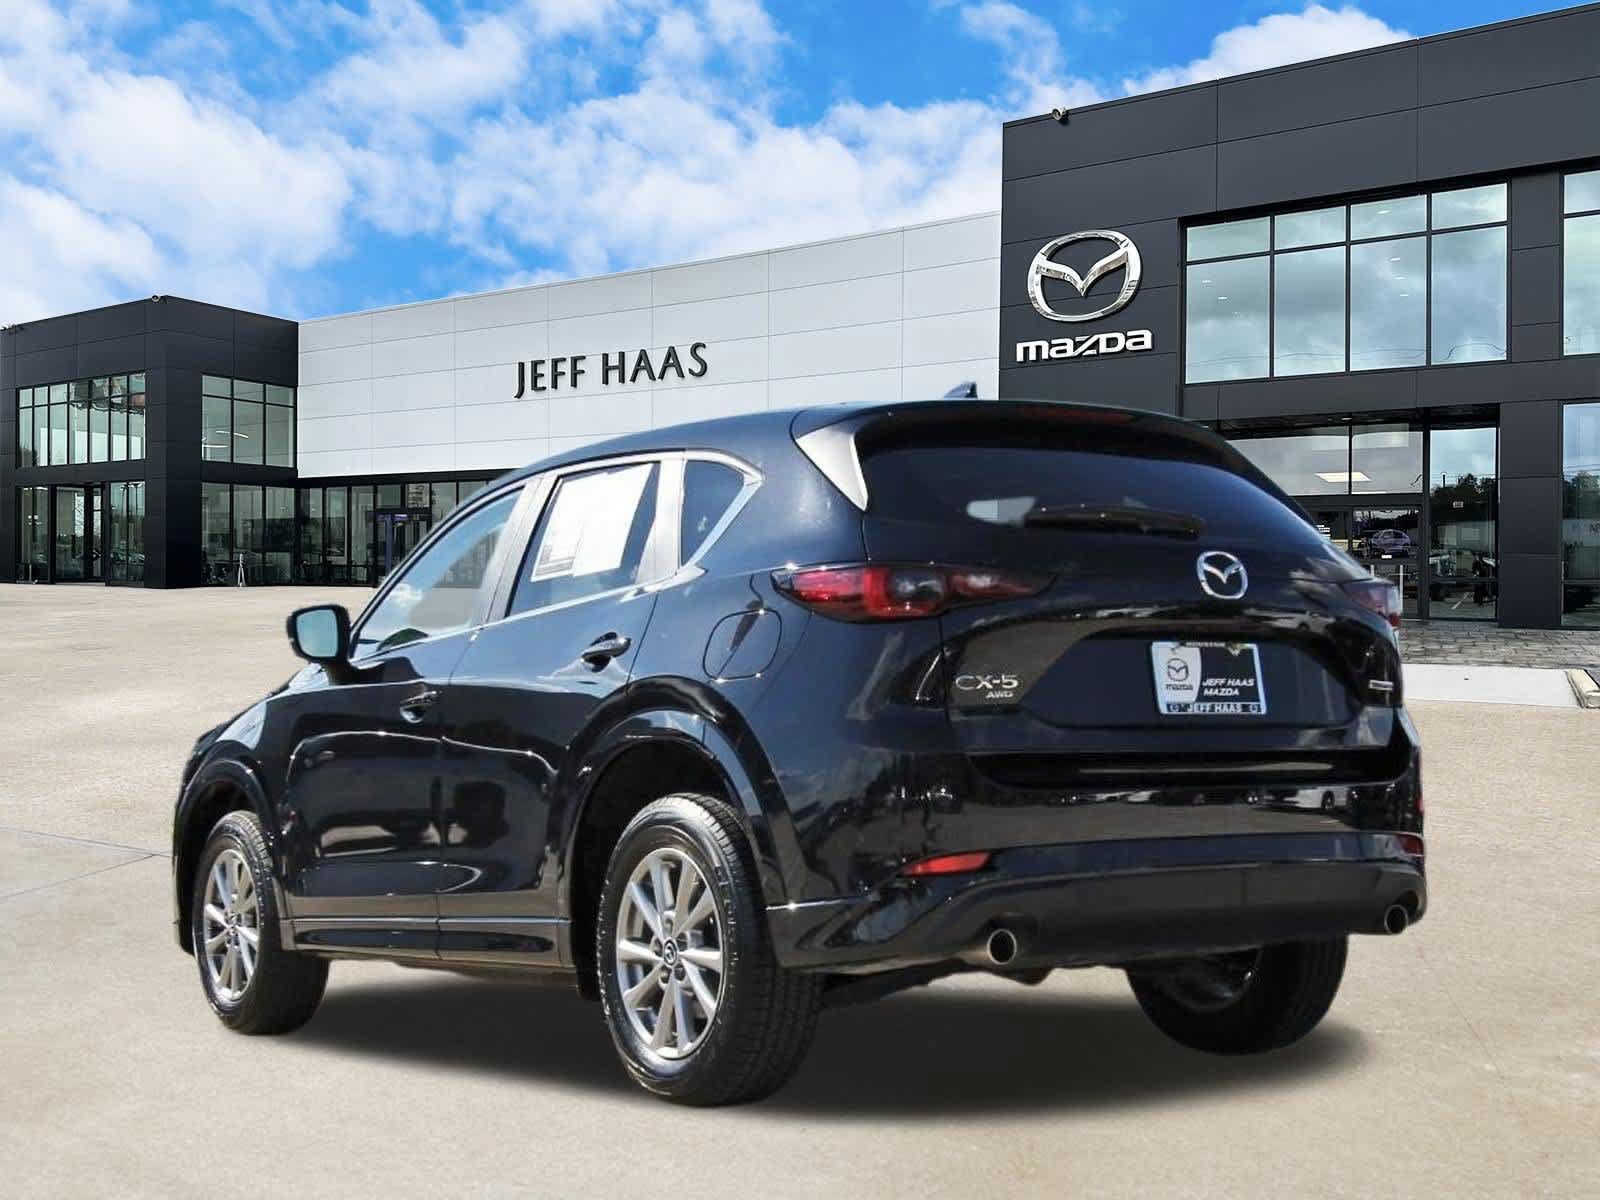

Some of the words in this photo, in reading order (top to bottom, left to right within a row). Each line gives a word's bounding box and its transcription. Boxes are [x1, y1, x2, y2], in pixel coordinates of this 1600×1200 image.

[514, 355, 587, 399] JEFF
[600, 342, 708, 385] HAAS
[955, 674, 1018, 690] CX-5
[1202, 678, 1226, 686] JEFF
[1226, 678, 1255, 686] HAAS
[984, 690, 1014, 699] AWD
[1203, 687, 1240, 696] MAZDA
[1187, 702, 1211, 713] JEFF
[1214, 702, 1242, 713] HAAS
